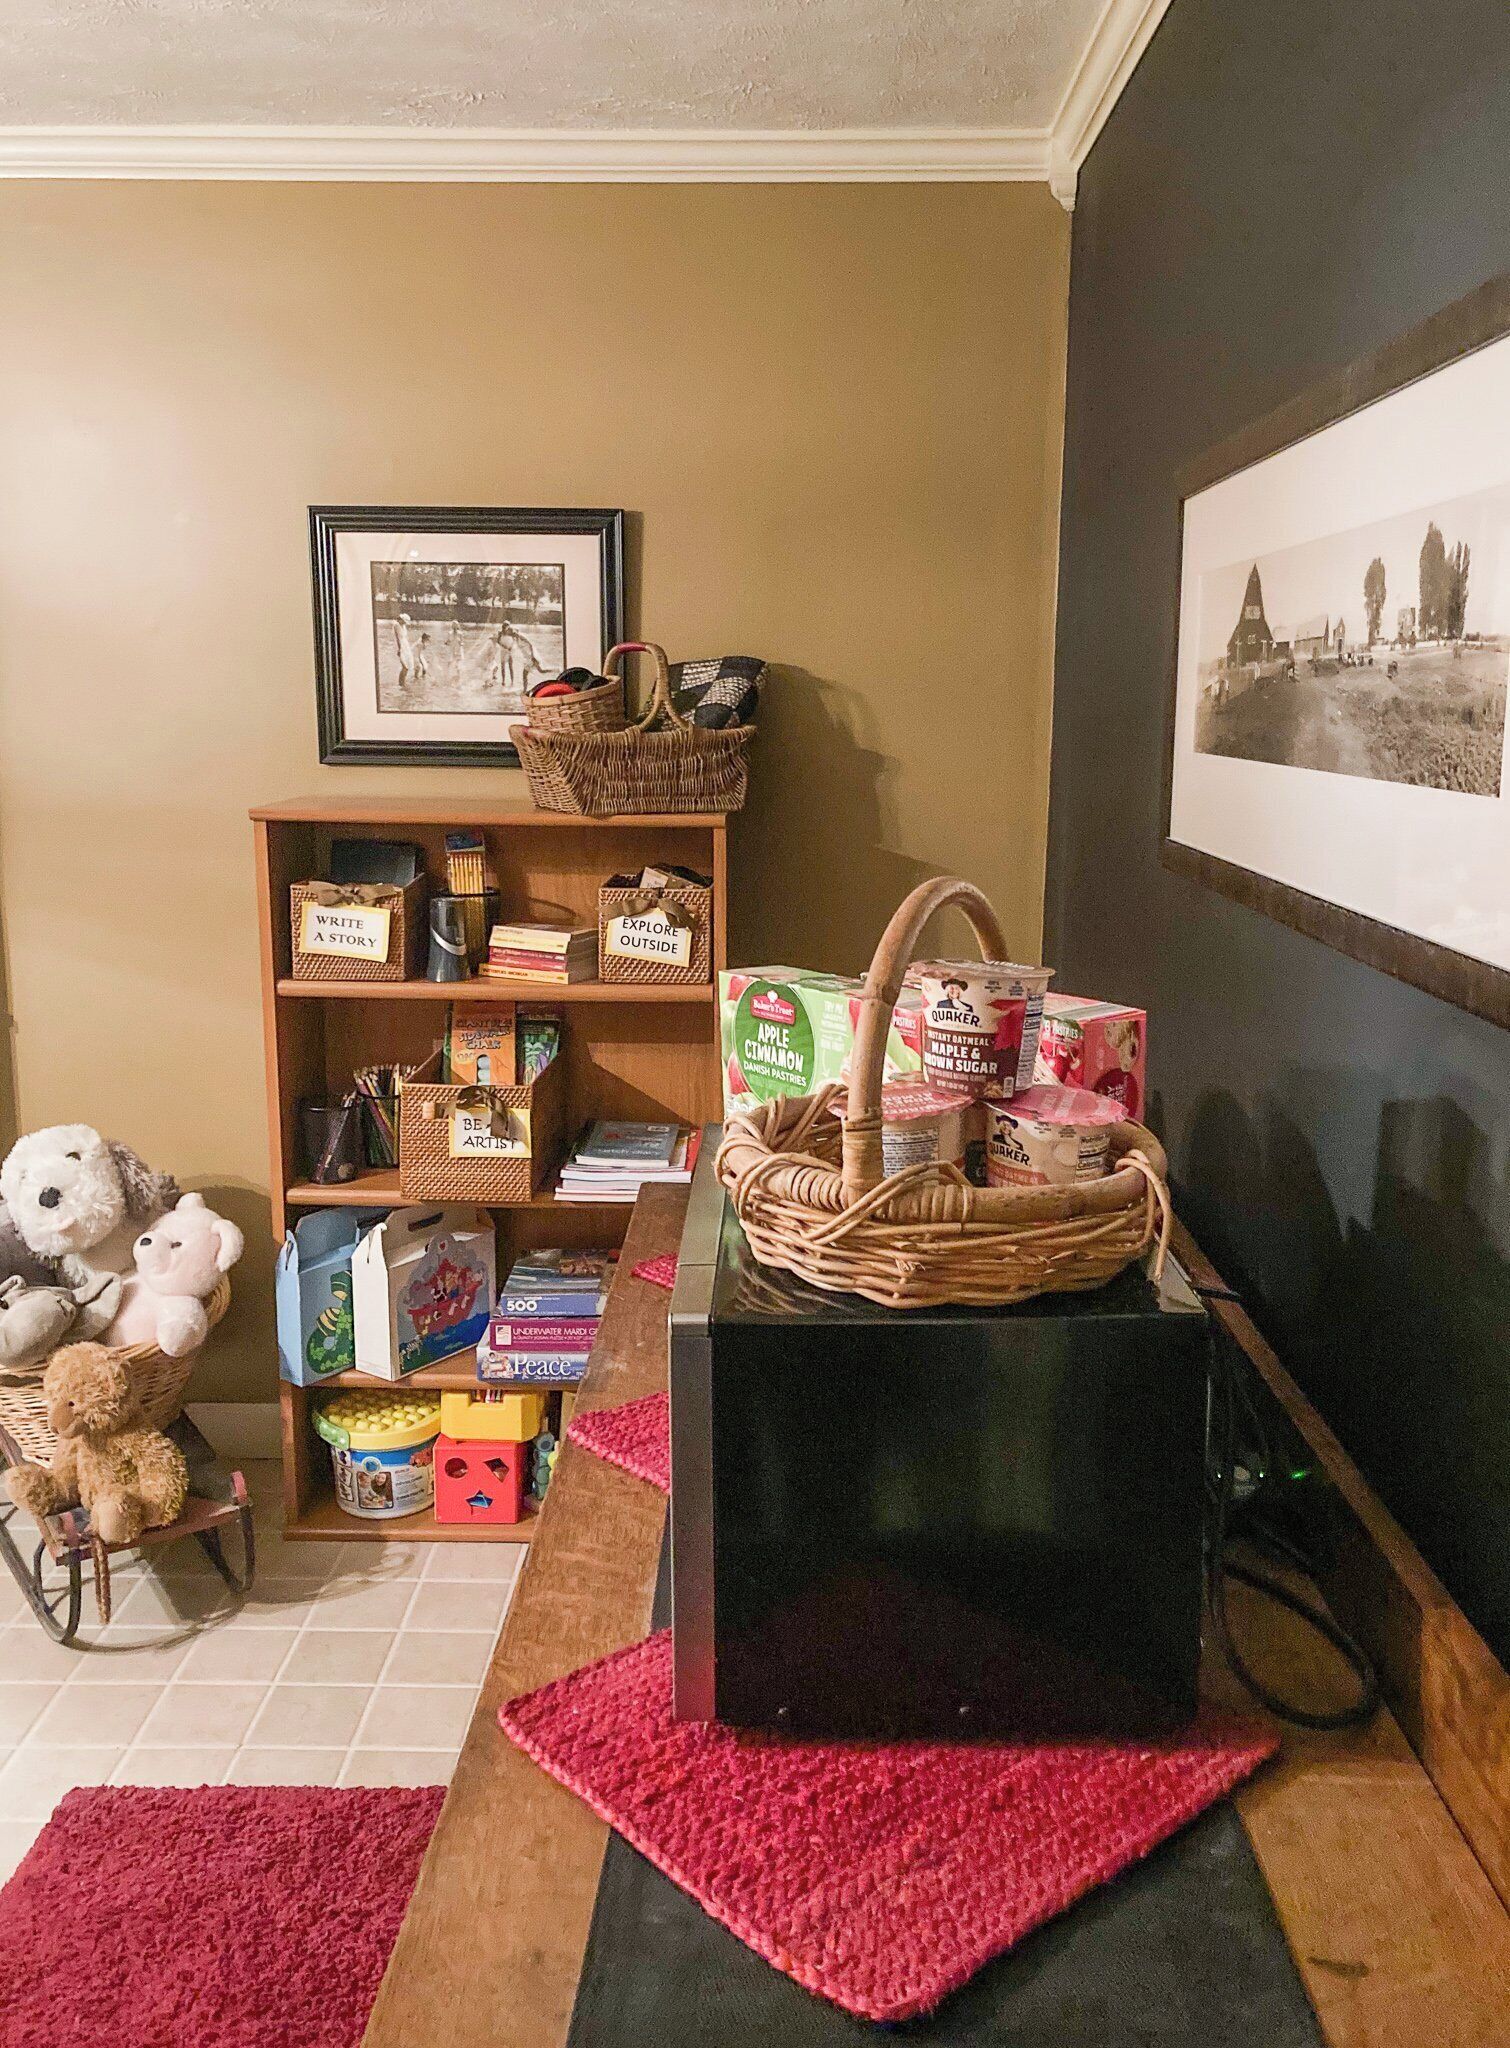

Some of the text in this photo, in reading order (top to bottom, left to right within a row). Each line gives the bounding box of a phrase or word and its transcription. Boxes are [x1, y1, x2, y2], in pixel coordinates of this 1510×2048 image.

[316, 915, 364, 929] WRITE
[622, 918, 679, 937] EXPLORE
[314, 932, 376, 948] A STORY
[620, 935, 678, 954] OUTSIDE
[753, 1000, 774, 1012] Baker's
[774, 1004, 793, 1016] Treat
[931, 1010, 980, 1027] QUAKER
[757, 1022, 789, 1049] APPLE
[926, 1030, 951, 1042] INSTANT
[952, 1035, 989, 1046] OATMEAL
[466, 1040, 501, 1050] CHALK
[931, 1041, 981, 1060] MAPLE &
[744, 1038, 804, 1073] CINNAMON
[743, 1060, 807, 1087] DANISH PASTRIES
[955, 1058, 997, 1074] SUGAR
[463, 1118, 482, 1131] BE
[462, 1136, 518, 1150] ARTIST
[989, 1141, 1031, 1166] QUAKER
[506, 1300, 538, 1312] 500
[512, 1327, 562, 1336] UNDERWATER
[564, 1327, 587, 1336] MARDI
[514, 1354, 571, 1376] Peace
